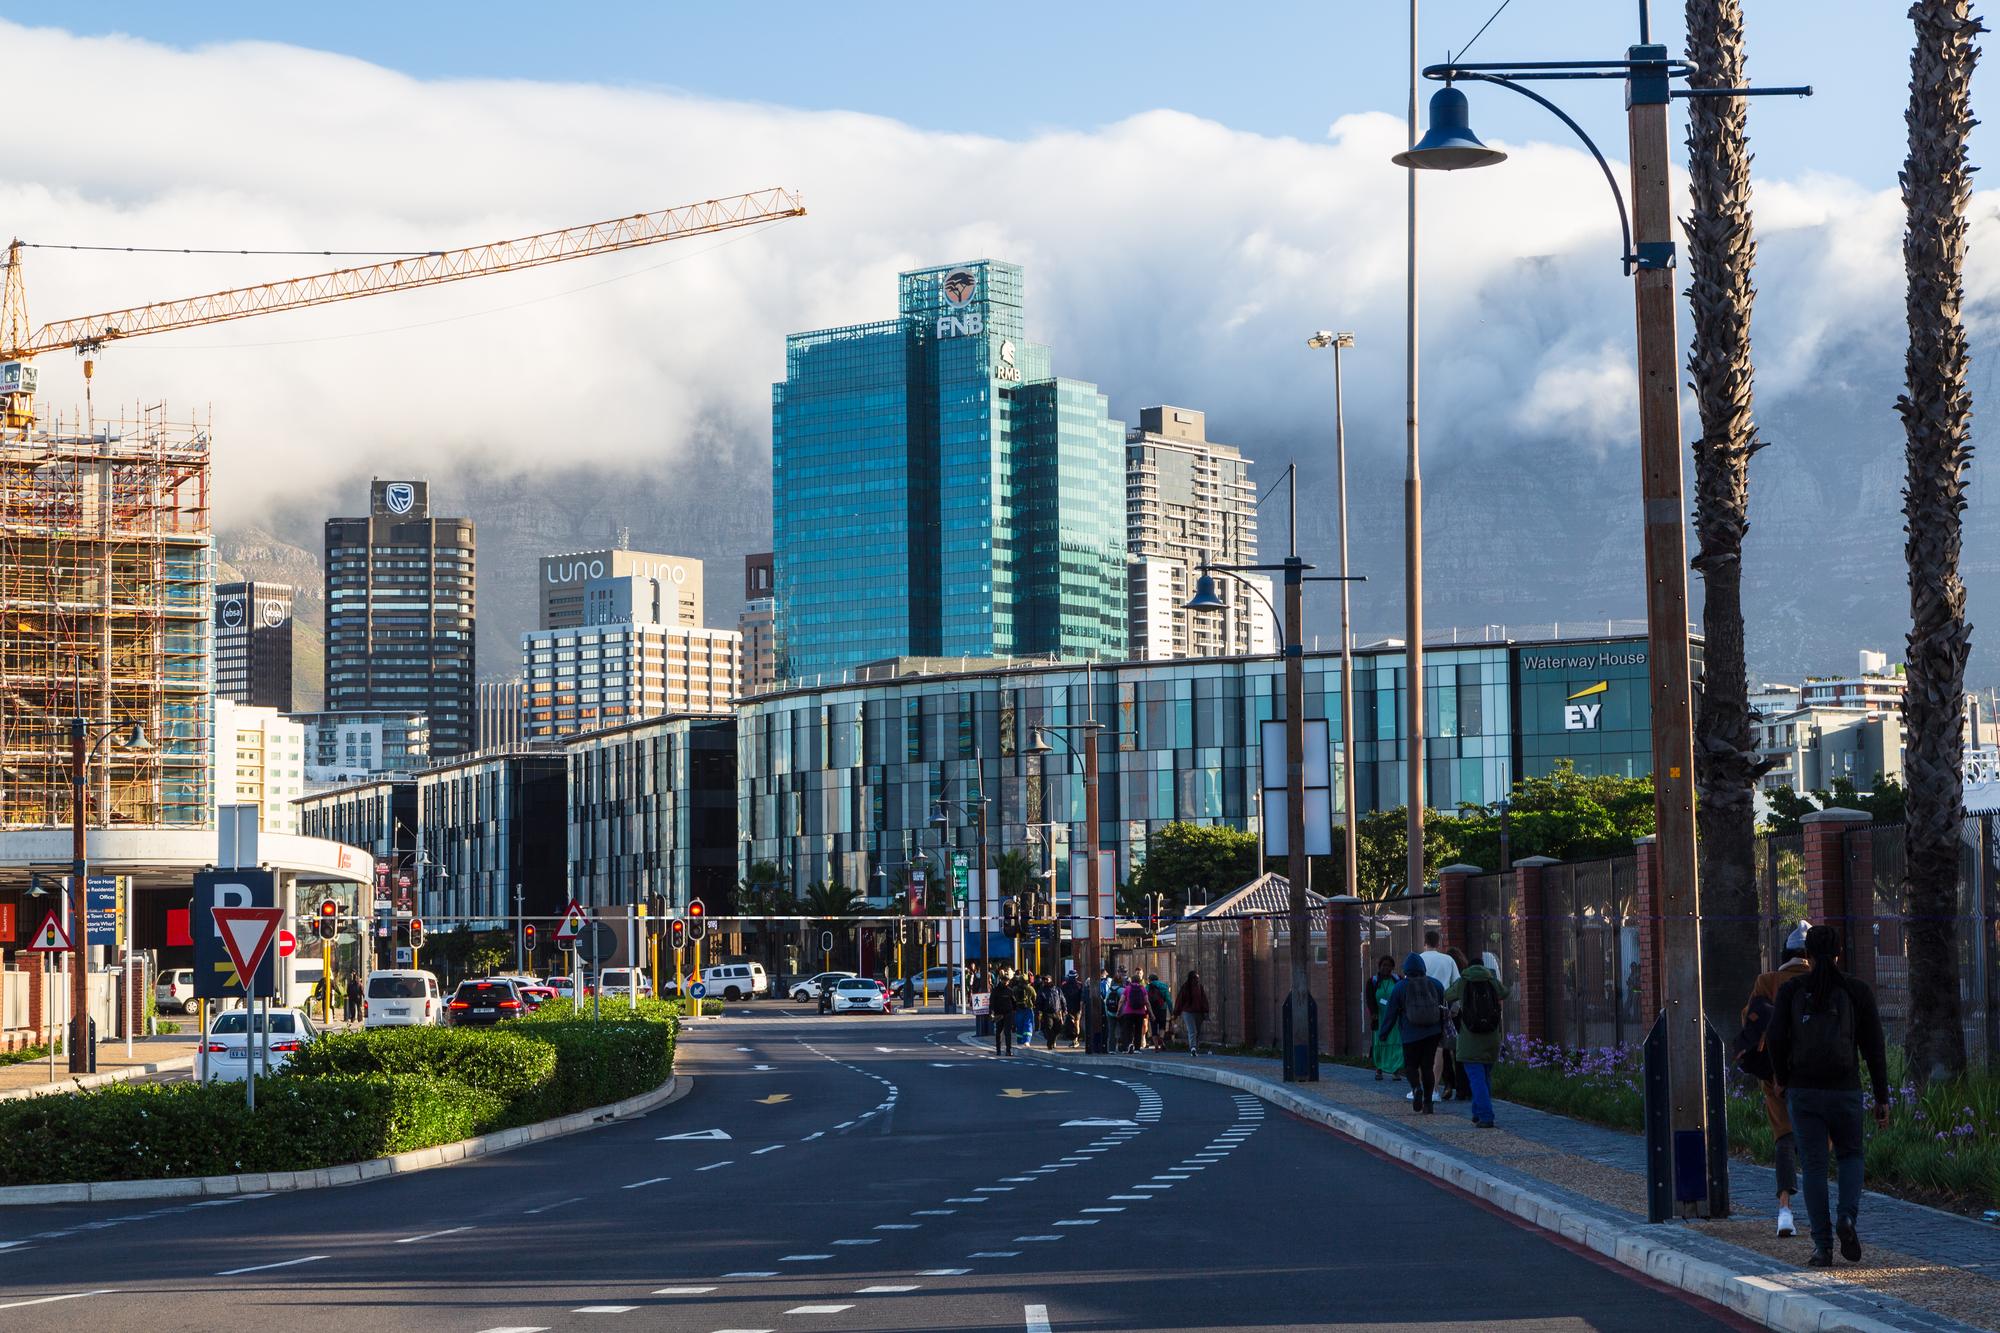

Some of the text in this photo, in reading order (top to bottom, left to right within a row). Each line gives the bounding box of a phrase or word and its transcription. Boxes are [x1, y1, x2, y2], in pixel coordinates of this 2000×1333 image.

[937, 313, 984, 339] FNB
[996, 366, 1021, 381] RMB
[548, 560, 604, 582] LUNO
[225, 607, 240, 617] absa
[266, 608, 281, 617] absa
[1523, 652, 1646, 670] Waterway House
[1564, 704, 1601, 729] EY
